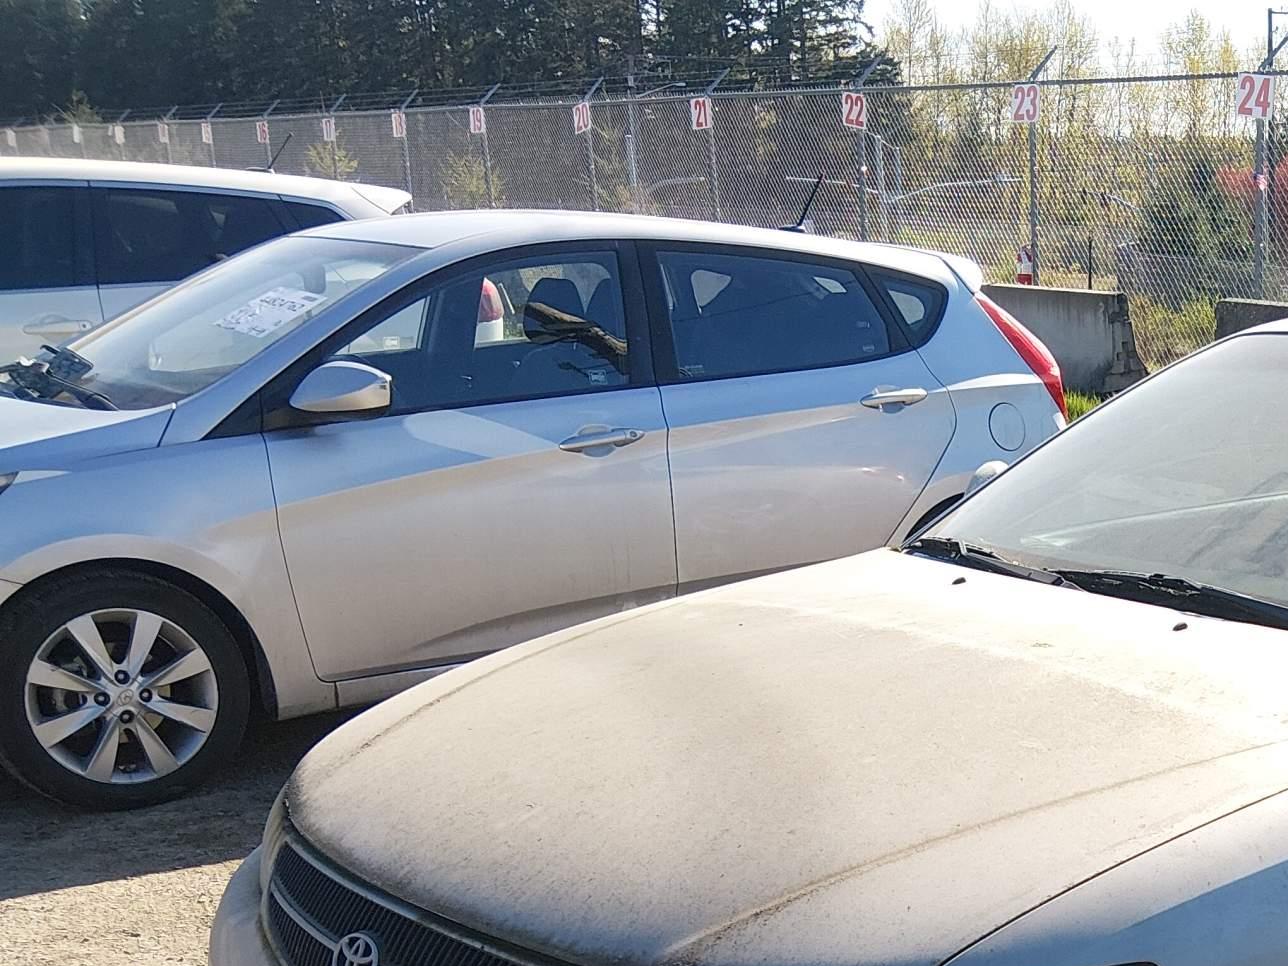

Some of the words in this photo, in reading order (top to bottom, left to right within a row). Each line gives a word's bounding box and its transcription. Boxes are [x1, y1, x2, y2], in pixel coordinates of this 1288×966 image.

[844, 94, 865, 127] 22
[1013, 86, 1038, 121] 23
[1238, 75, 1271, 117] 24
[472, 107, 483, 132] 19
[575, 103, 590, 132] 20
[694, 99, 709, 127] 21
